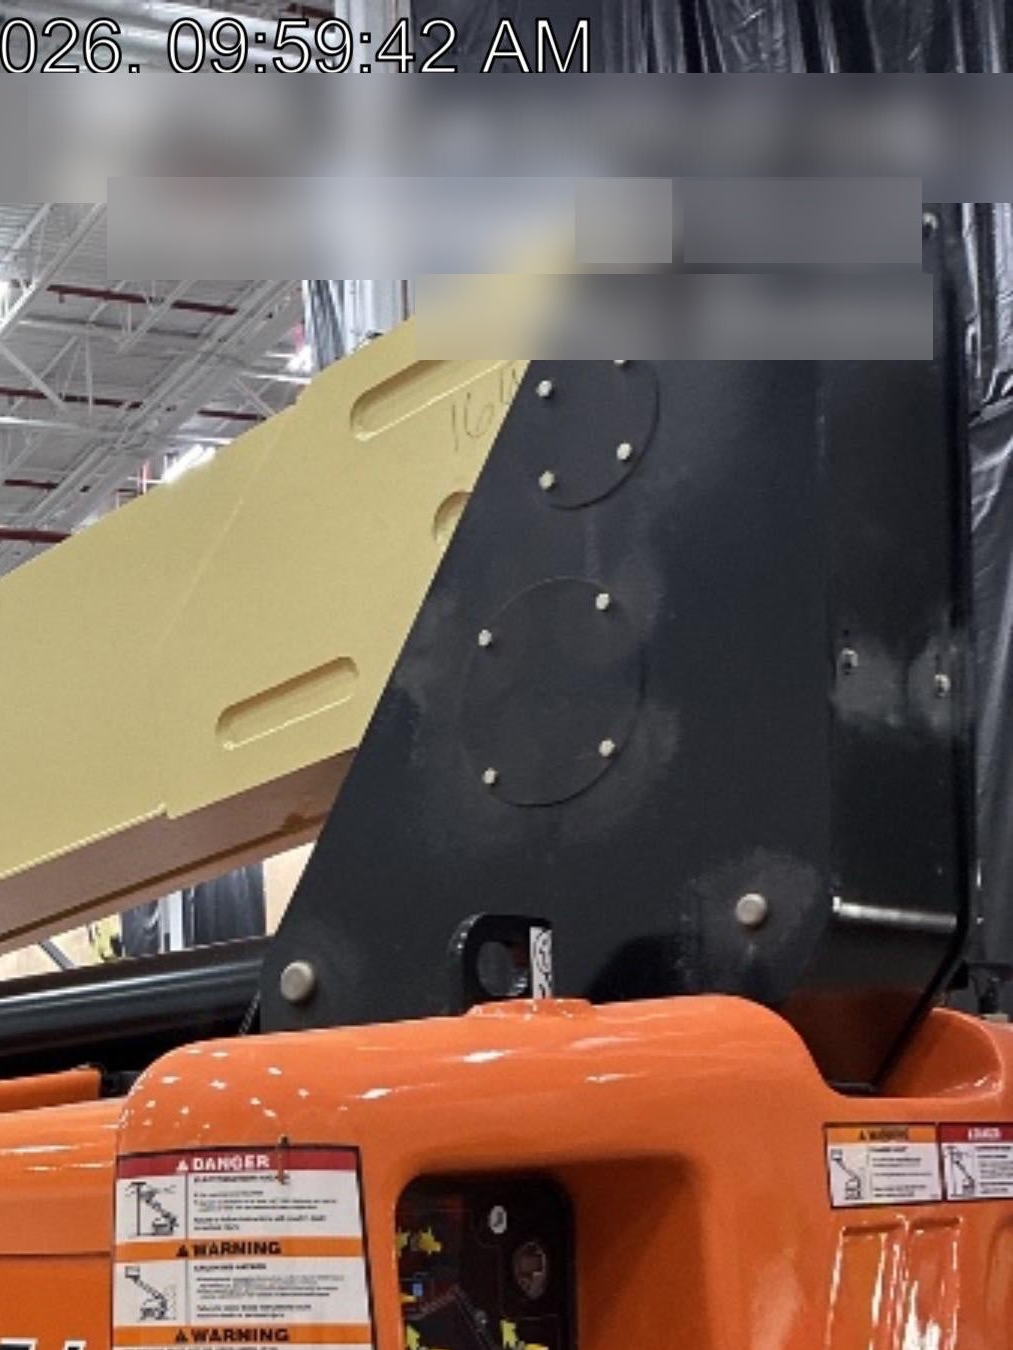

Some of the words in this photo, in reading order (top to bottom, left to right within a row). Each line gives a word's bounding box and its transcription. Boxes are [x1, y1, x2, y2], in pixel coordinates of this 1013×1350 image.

[192, 1154, 270, 1172] DANGER
[193, 1241, 282, 1257] WARNING
[192, 1328, 290, 1343] WARNING
